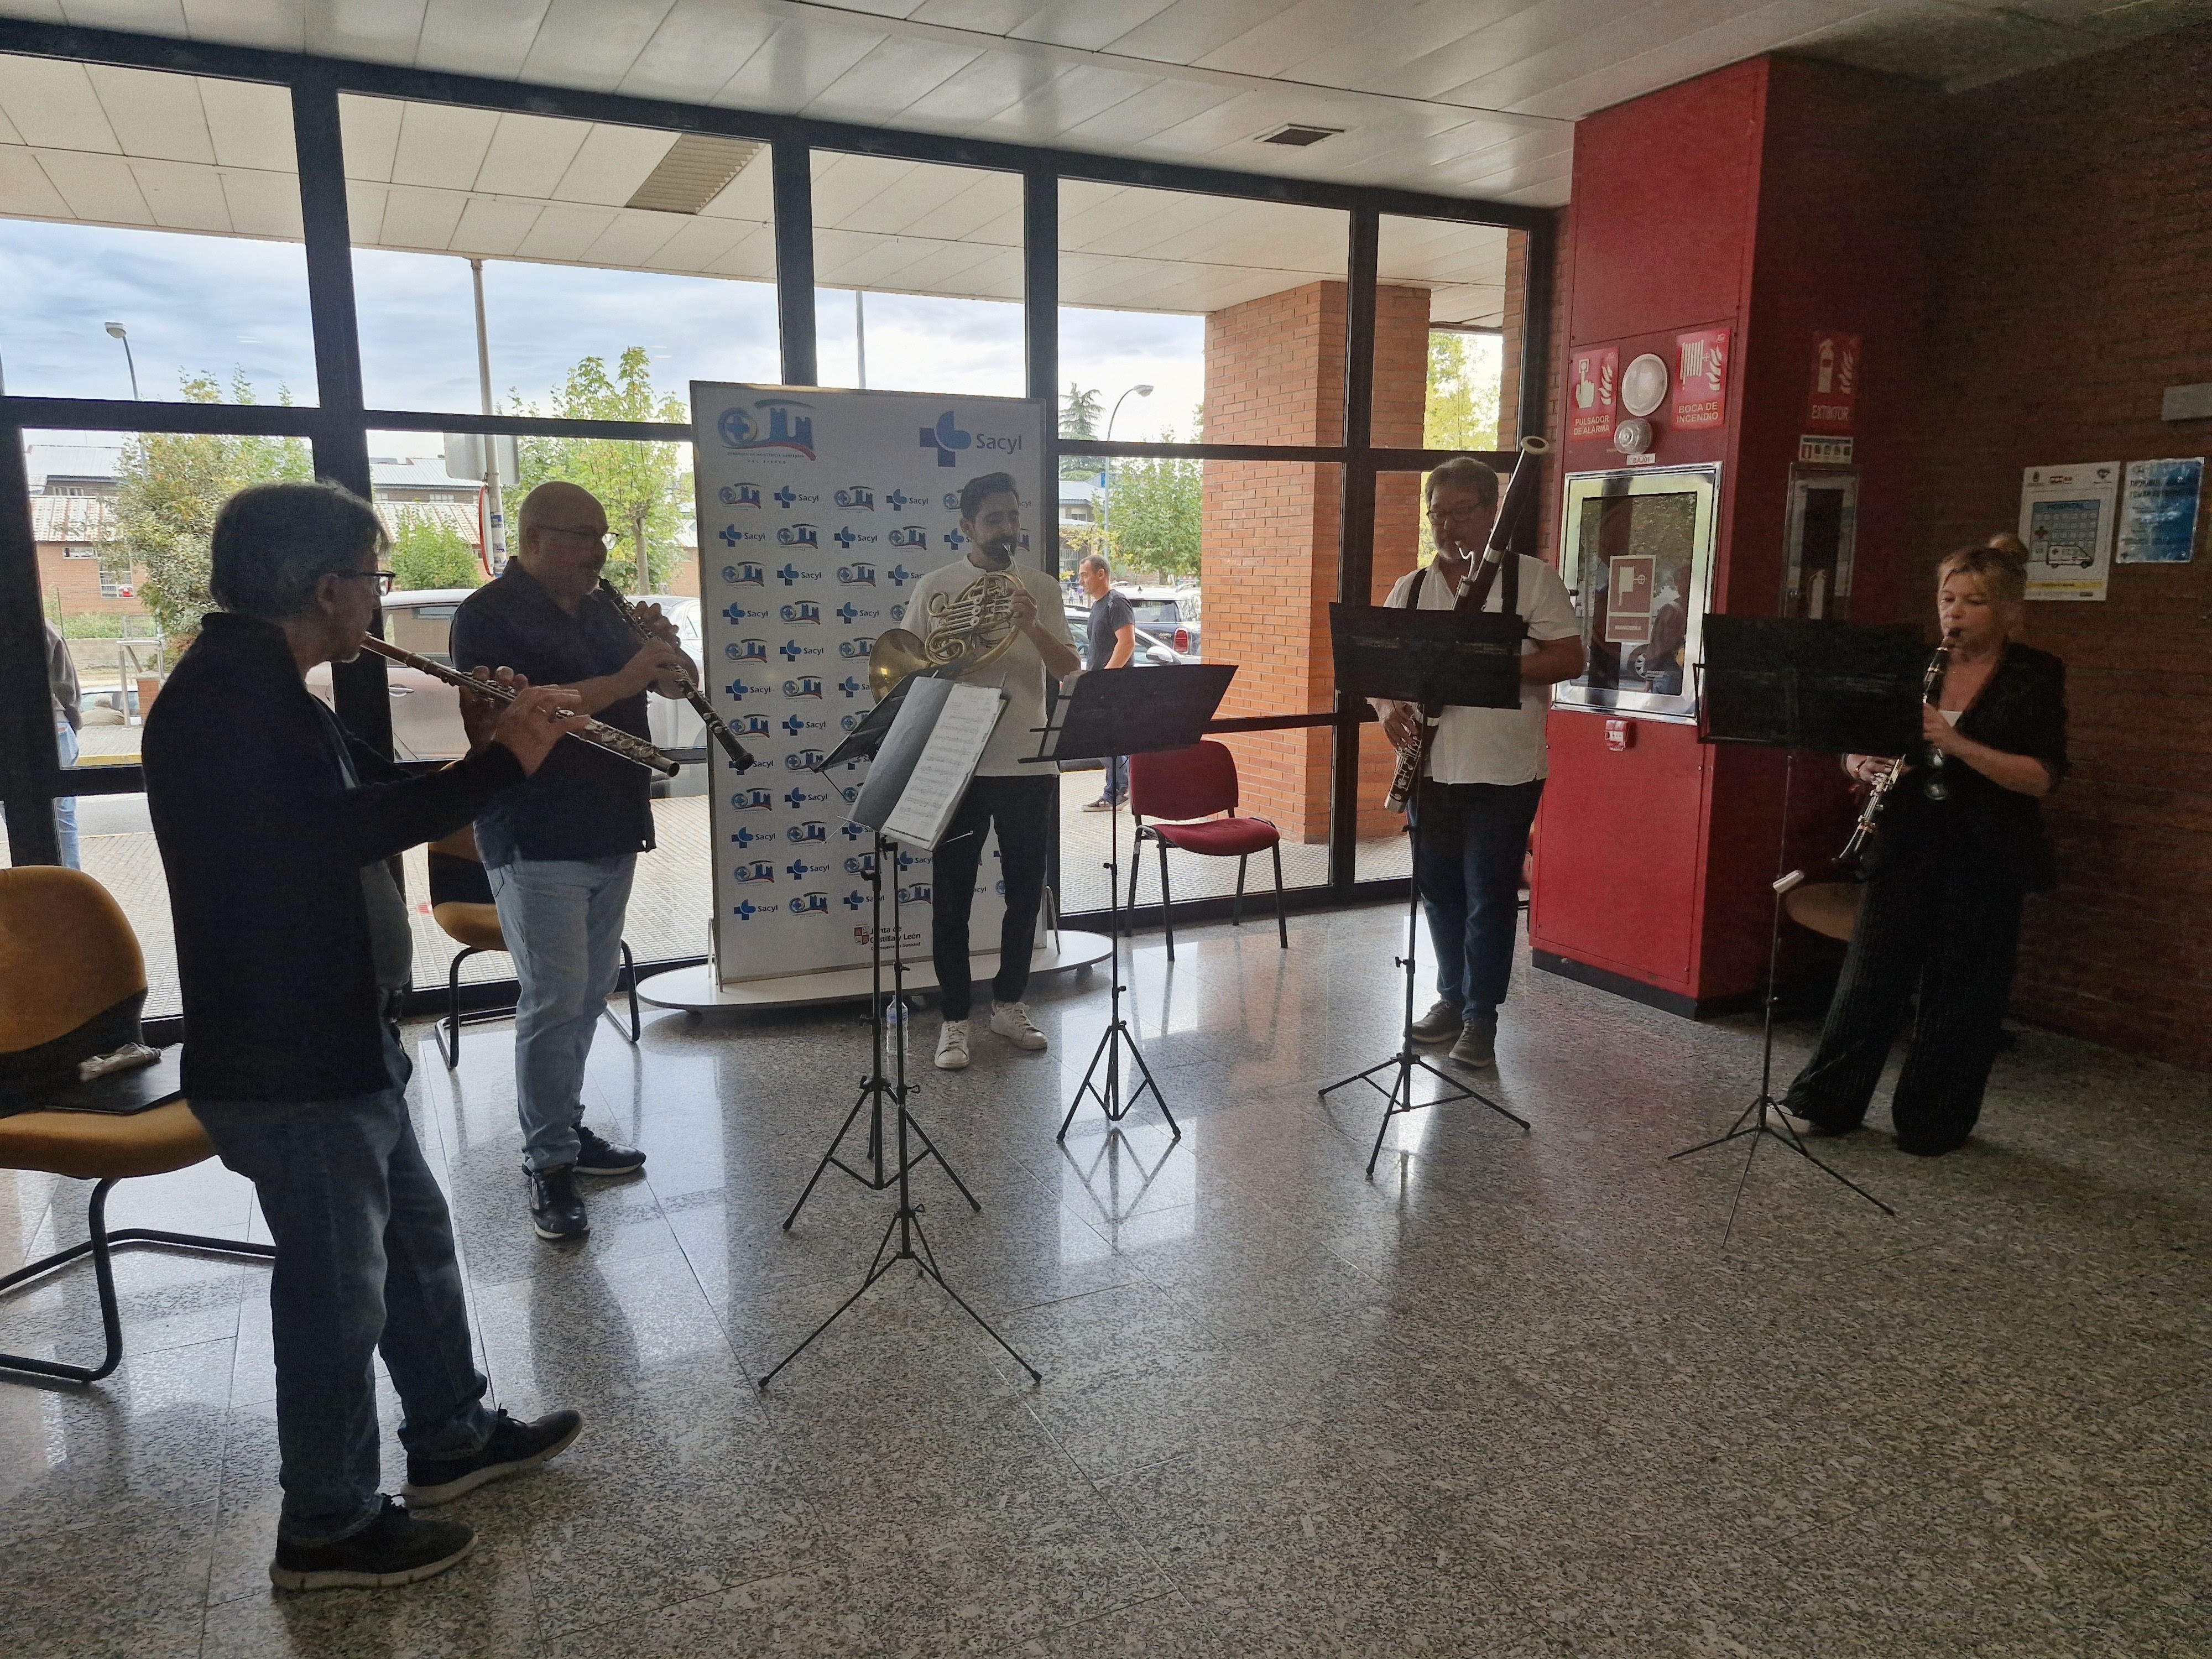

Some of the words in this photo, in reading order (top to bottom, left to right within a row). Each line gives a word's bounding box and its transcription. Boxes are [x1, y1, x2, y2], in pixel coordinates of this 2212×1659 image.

[1679, 404, 1703, 414] BOCA
[1706, 401, 1718, 410] DE
[1575, 415, 1609, 426] PULSADOR
[1677, 412, 1718, 423] INCENDIO
[1574, 426, 1582, 435] DE
[1582, 424, 1610, 434] ALARMA
[976, 433, 1022, 454] Sacyl
[798, 494, 819, 503] Sacyl
[909, 497, 928, 506] Sacyl
[744, 532, 765, 541] Sacyl
[858, 534, 878, 543] Sacyl
[801, 571, 821, 580] Sacyl
[747, 609, 768, 618] Sacyl
[859, 609, 879, 618] Sacyl
[750, 686, 771, 695] Sacyl
[754, 760, 774, 768] Sacyl
[808, 794, 828, 802] Sacyl
[756, 833, 776, 841] Sacyl
[810, 864, 830, 873] Sacyl
[870, 935, 895, 943] Cstilla
